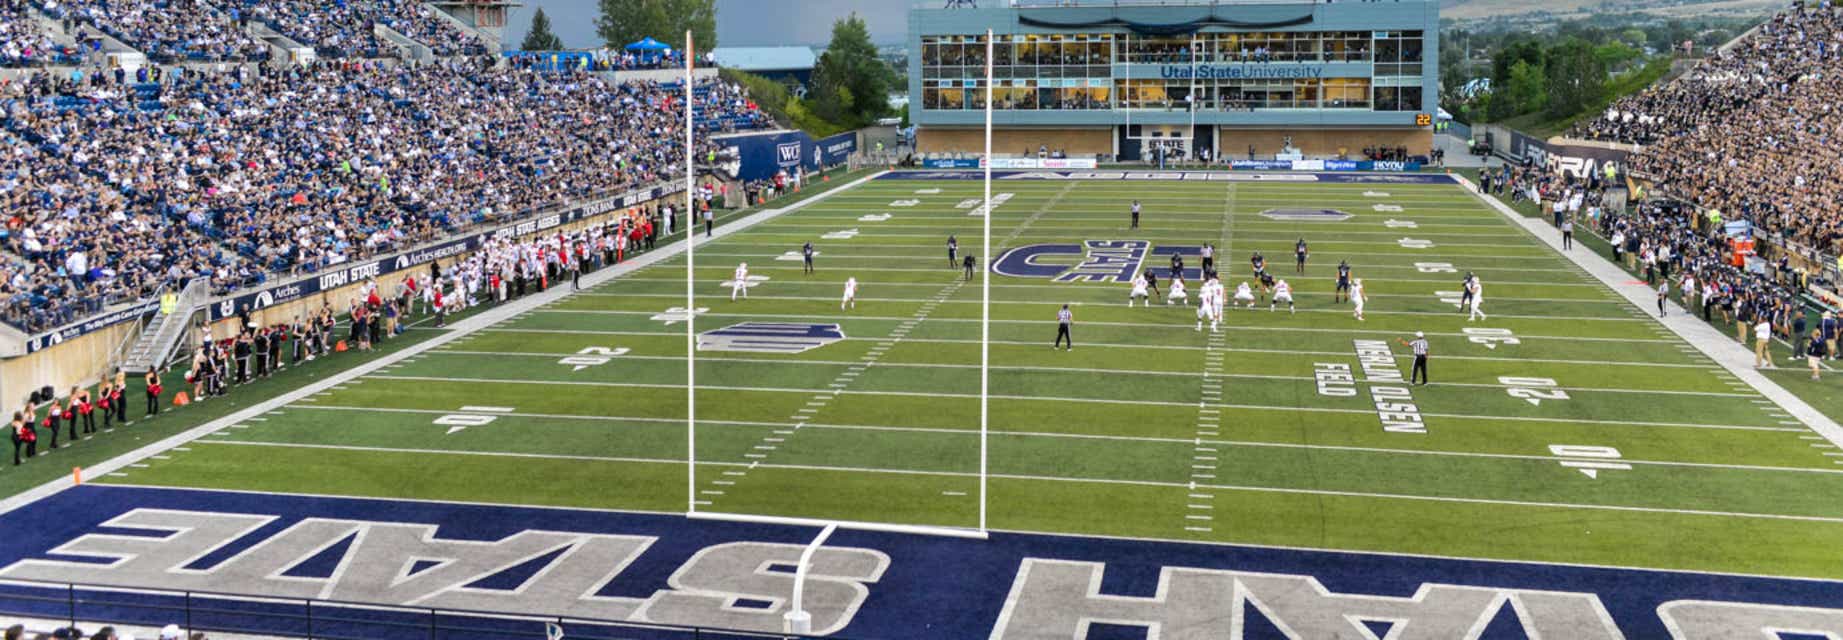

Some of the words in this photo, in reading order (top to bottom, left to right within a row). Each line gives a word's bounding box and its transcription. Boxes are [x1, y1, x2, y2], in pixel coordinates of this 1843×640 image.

[1416, 114, 1431, 126] 22
[320, 271, 348, 291] UTAH
[351, 262, 380, 282] STATE
[557, 346, 631, 365] 20
[1353, 339, 1403, 382] MERLIN
[1313, 362, 1358, 396] FIELD
[1498, 376, 1571, 400] 20
[432, 406, 516, 426] 10
[1369, 385, 1428, 434] OLSEN
[1548, 444, 1633, 470] 10
[0, 508, 891, 636] STATE
